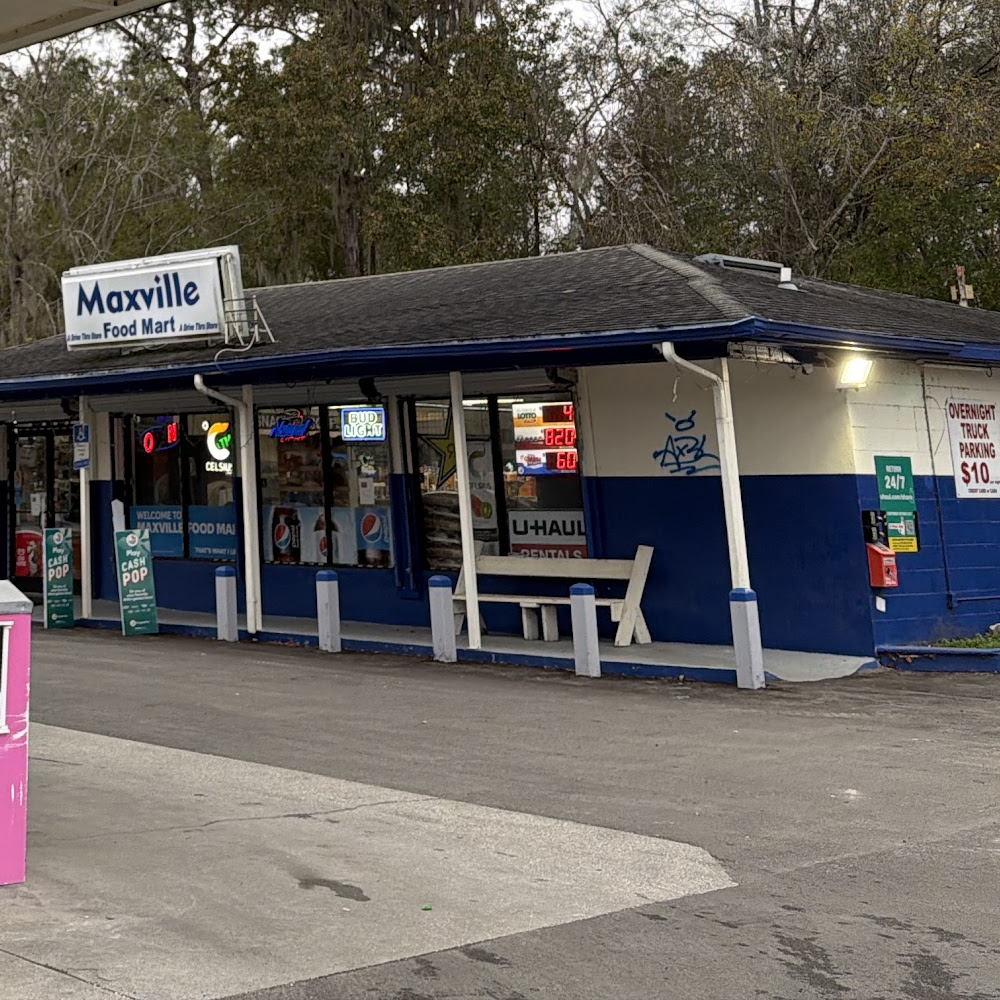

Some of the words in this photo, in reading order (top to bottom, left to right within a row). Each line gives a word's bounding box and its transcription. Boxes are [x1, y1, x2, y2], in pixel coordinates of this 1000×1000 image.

[77, 272, 200, 316] Maxville
[103, 320, 137, 339] Food
[141, 315, 175, 335] Mart
[349, 411, 379, 425] BUD
[517, 412, 537, 420] LOTTO
[563, 405, 574, 421] 4
[948, 402, 996, 421] OVERNIGHT
[343, 422, 384, 438] LIGHT
[545, 428, 576, 446] 820
[960, 422, 990, 440] TRUCK
[958, 441, 996, 459] PARKING
[557, 451, 578, 470] 60
[884, 474, 905, 490] 24/7
[960, 461, 990, 487] $10
[136, 510, 172, 520] WELCOME
[173, 511, 183, 520] TO
[513, 519, 586, 536] U-HAUL
[52, 546, 65, 555] Play
[126, 549, 141, 557] Play
[48, 554, 69, 568] CASH
[121, 556, 146, 572] CASH
[48, 563, 70, 582] POP
[122, 566, 148, 587] POP
